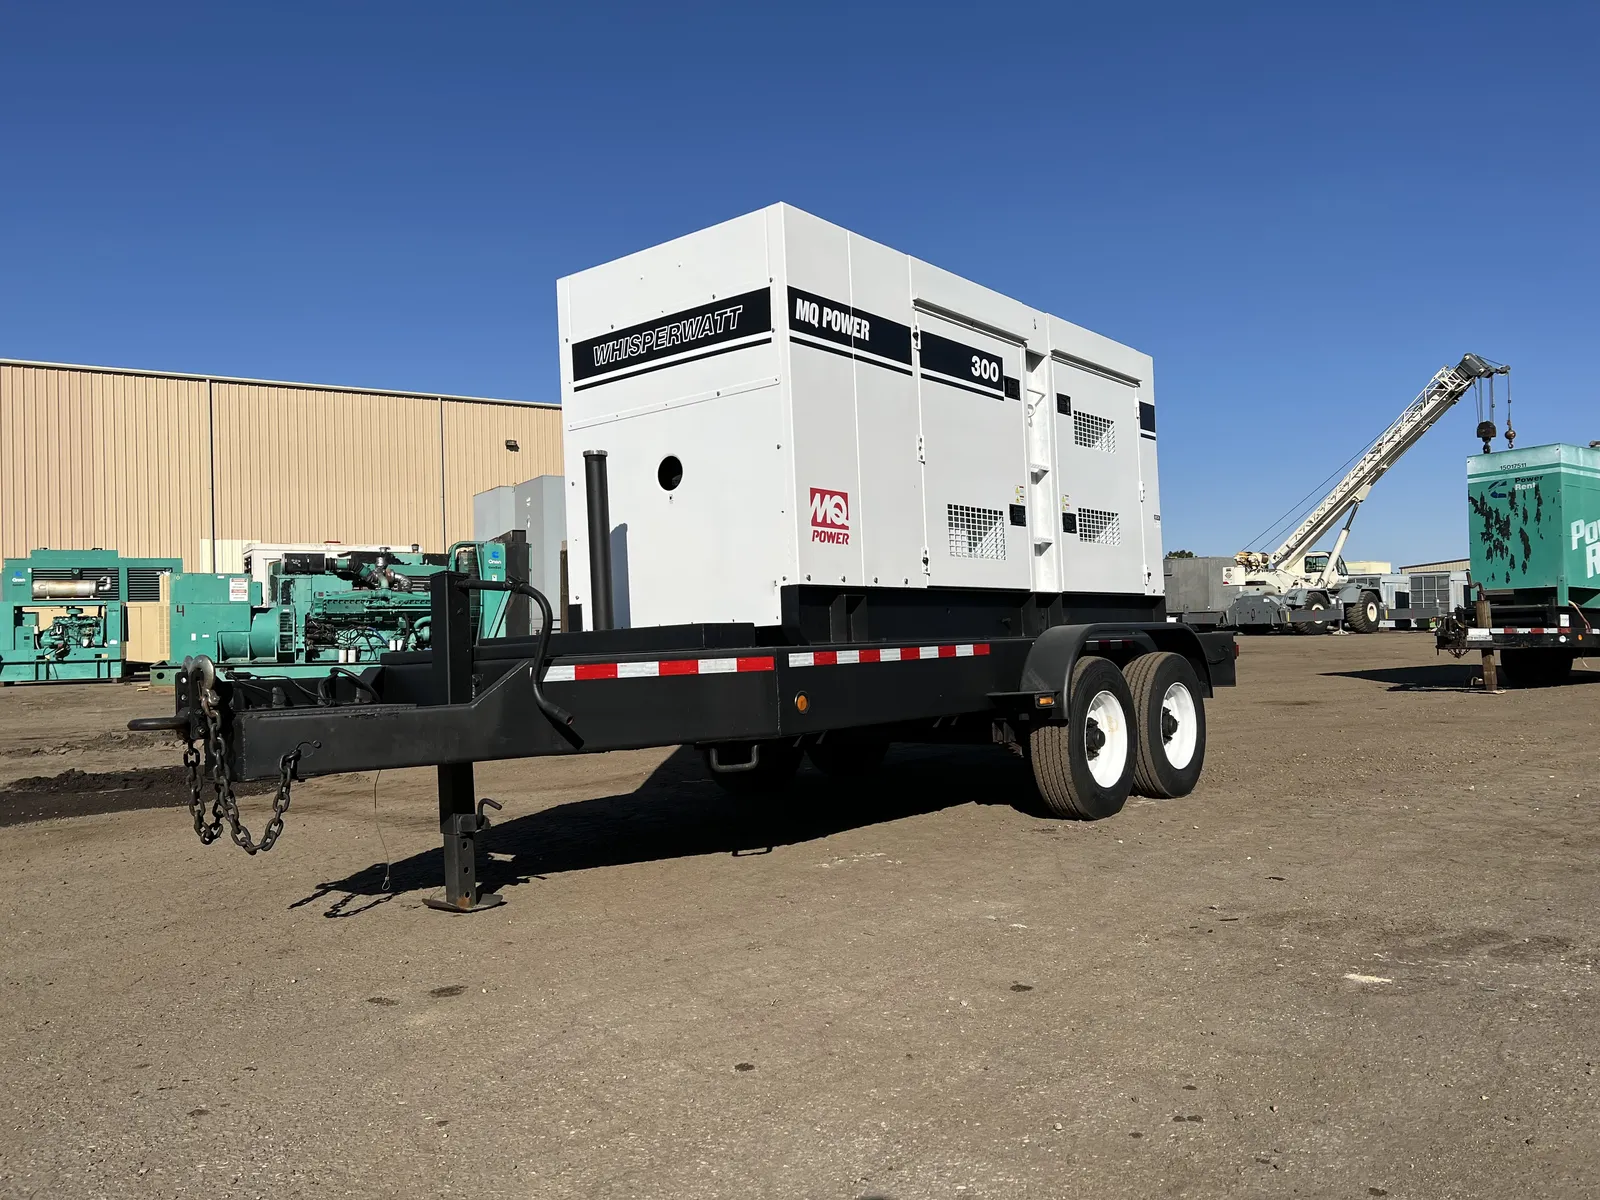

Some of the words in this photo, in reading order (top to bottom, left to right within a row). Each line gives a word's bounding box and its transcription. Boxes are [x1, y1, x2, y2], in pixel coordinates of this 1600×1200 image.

[593, 304, 743, 367] WHISPERWATT
[795, 298, 820, 328] MQ
[822, 306, 870, 341] POWER
[971, 355, 999, 383] 300
[1514, 475, 1544, 484] Power
[810, 492, 849, 526] MQ
[812, 529, 850, 545] POWER
[1571, 518, 1600, 551] Po
